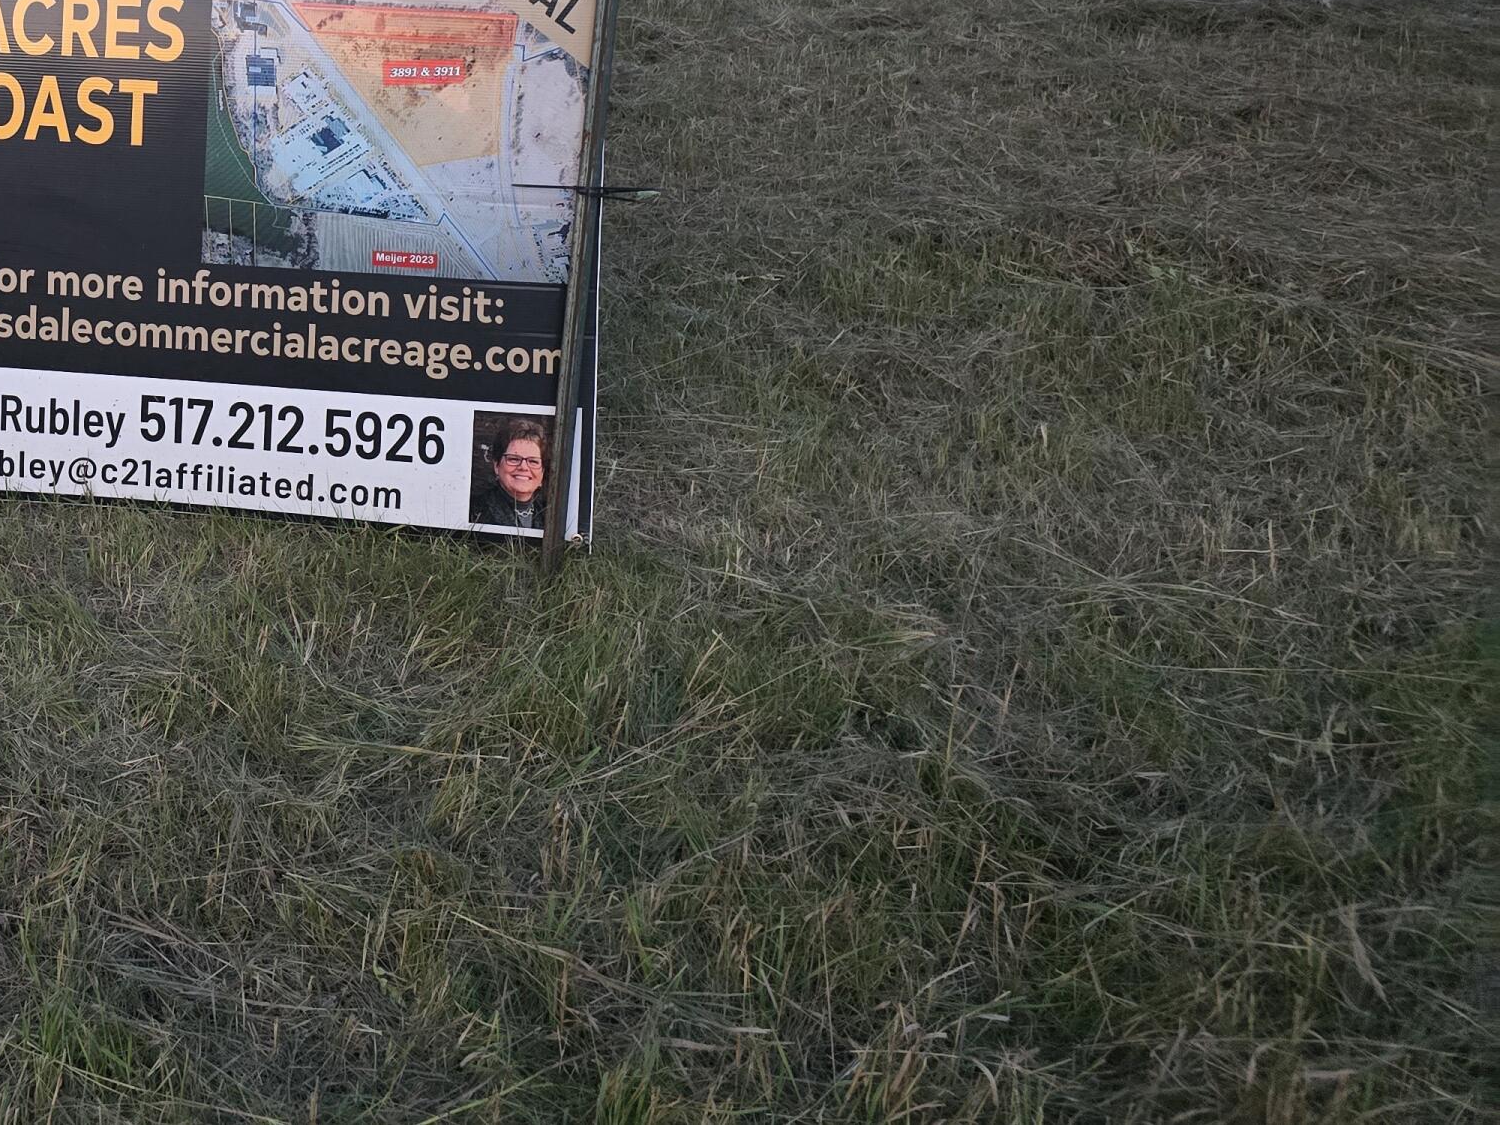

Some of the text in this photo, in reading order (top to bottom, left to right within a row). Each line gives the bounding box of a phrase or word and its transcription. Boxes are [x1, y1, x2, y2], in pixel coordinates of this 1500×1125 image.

[389, 65, 461, 78] 3891 & 3911
[375, 252, 434, 264] Meijer 2023
[47, 268, 142, 302] more
[157, 268, 391, 318] information
[404, 284, 505, 325] visit:
[1, 394, 126, 449] Rubley
[139, 394, 446, 466] 517.212.5926
